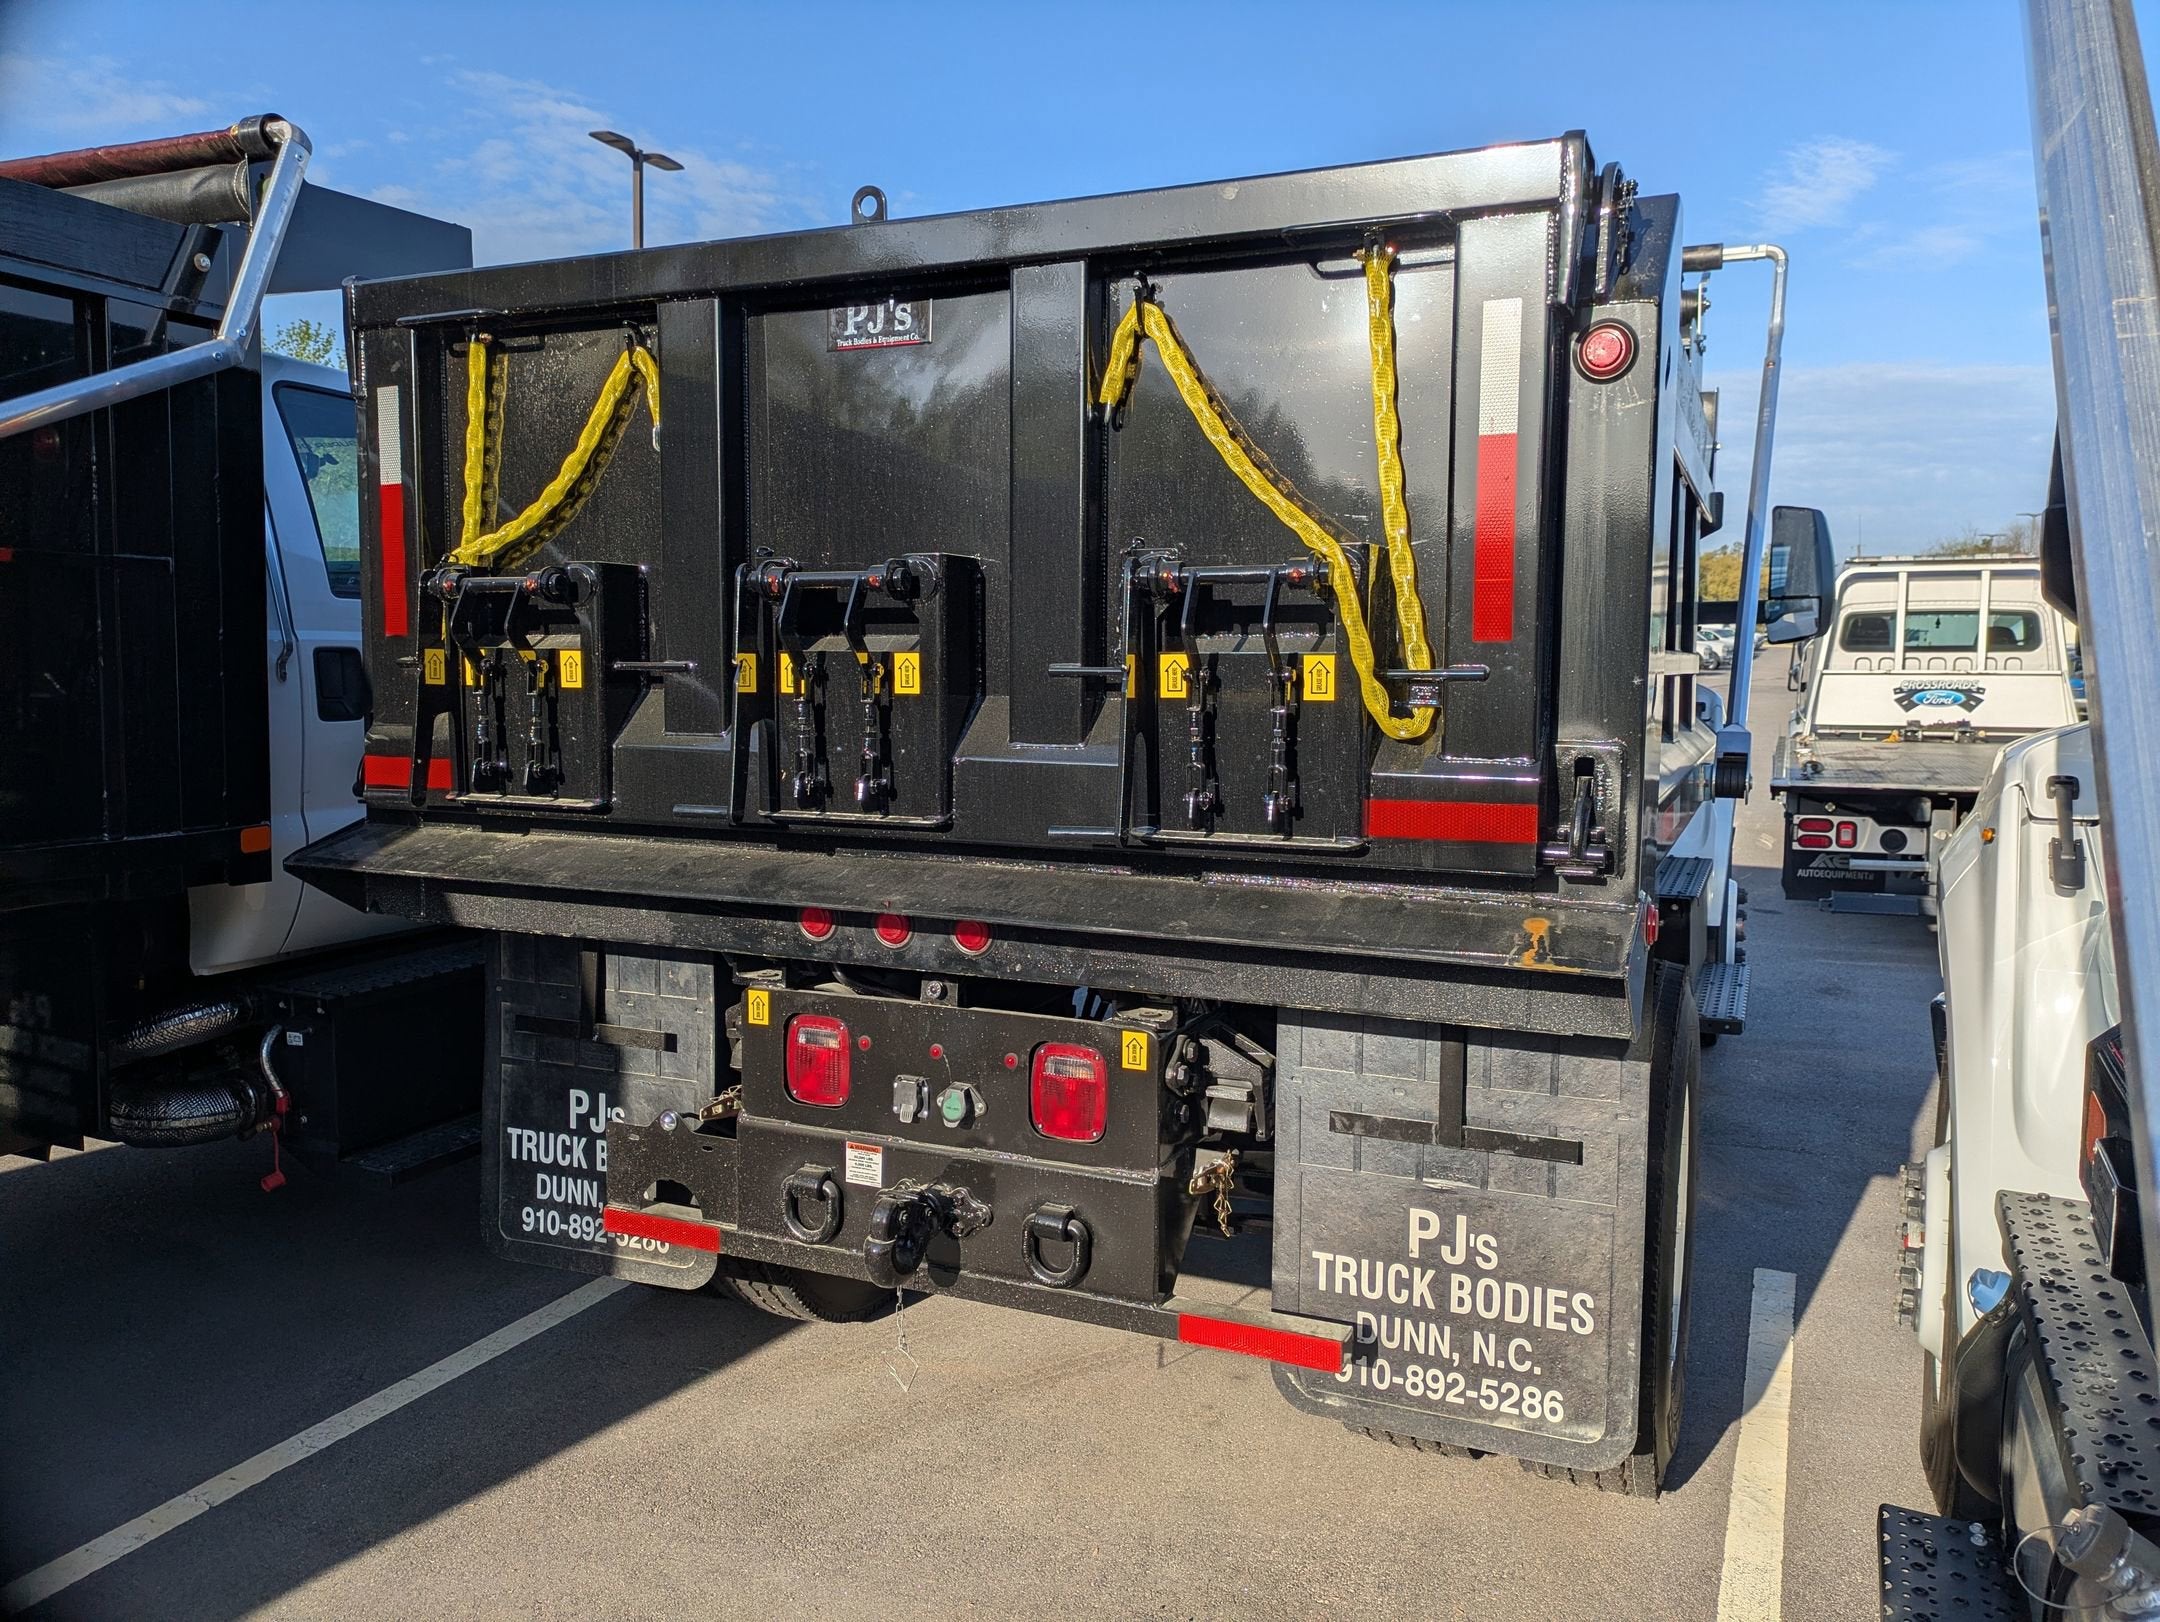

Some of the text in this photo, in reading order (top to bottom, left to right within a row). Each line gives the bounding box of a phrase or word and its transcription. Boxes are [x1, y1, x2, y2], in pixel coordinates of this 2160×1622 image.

[837, 339, 852, 347] Truck
[853, 337, 872, 346] Bodies
[878, 334, 909, 346] Equipment
[1901, 680, 1979, 690] CROSSROADS
[1923, 692, 1955, 704] Ford
[507, 1126, 588, 1169] TRUCK
[536, 1172, 604, 1213] DUNN,
[1312, 1251, 1595, 1335] TRUCK BODIES
[1356, 1311, 1542, 1375] DUNN, N.C.
